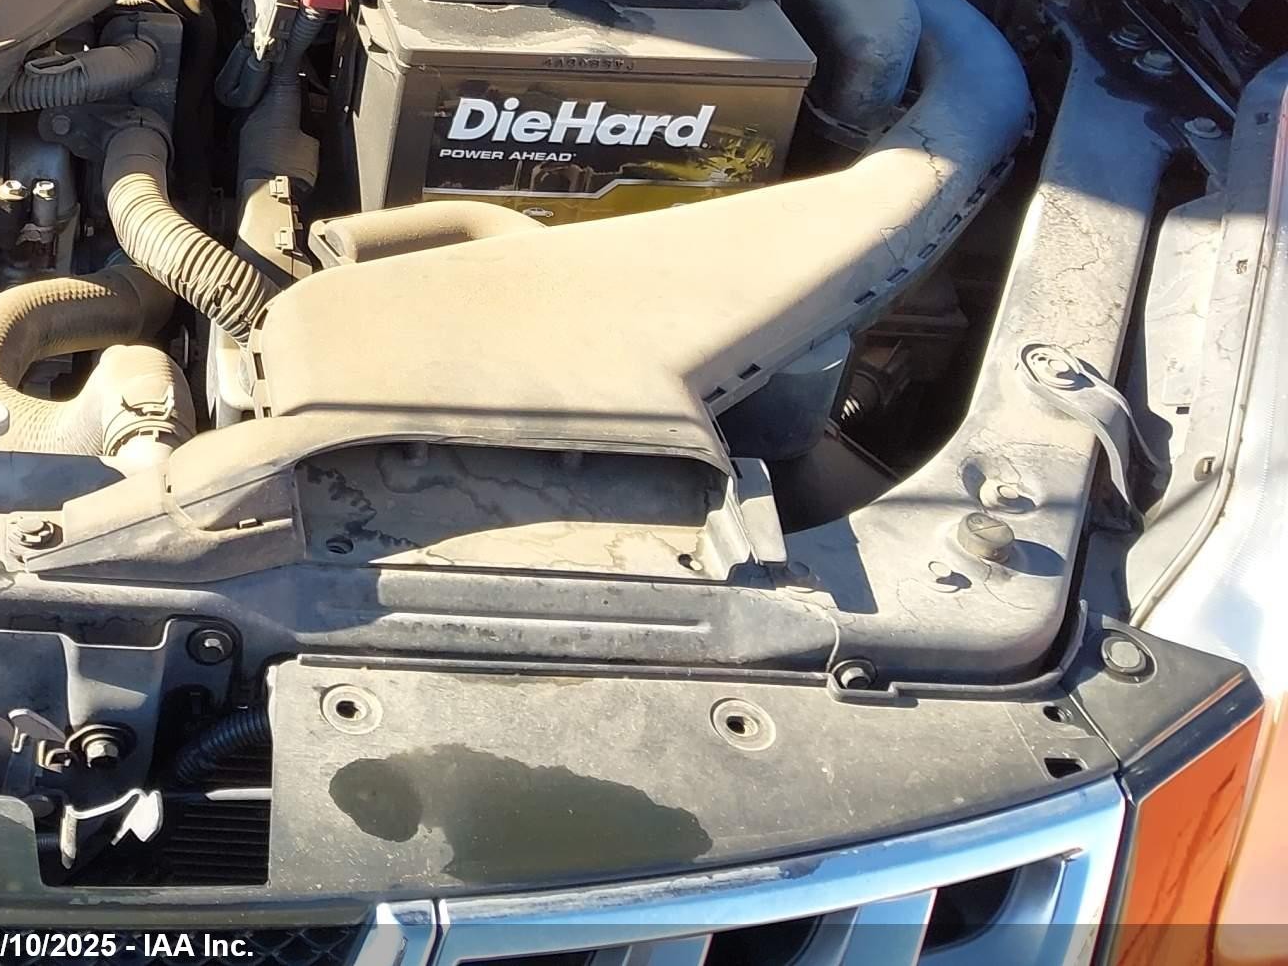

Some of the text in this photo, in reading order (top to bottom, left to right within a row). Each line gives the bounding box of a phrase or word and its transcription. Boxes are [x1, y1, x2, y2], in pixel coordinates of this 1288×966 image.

[447, 97, 717, 148] DieHard
[439, 148, 573, 162] POWER AHEAD
